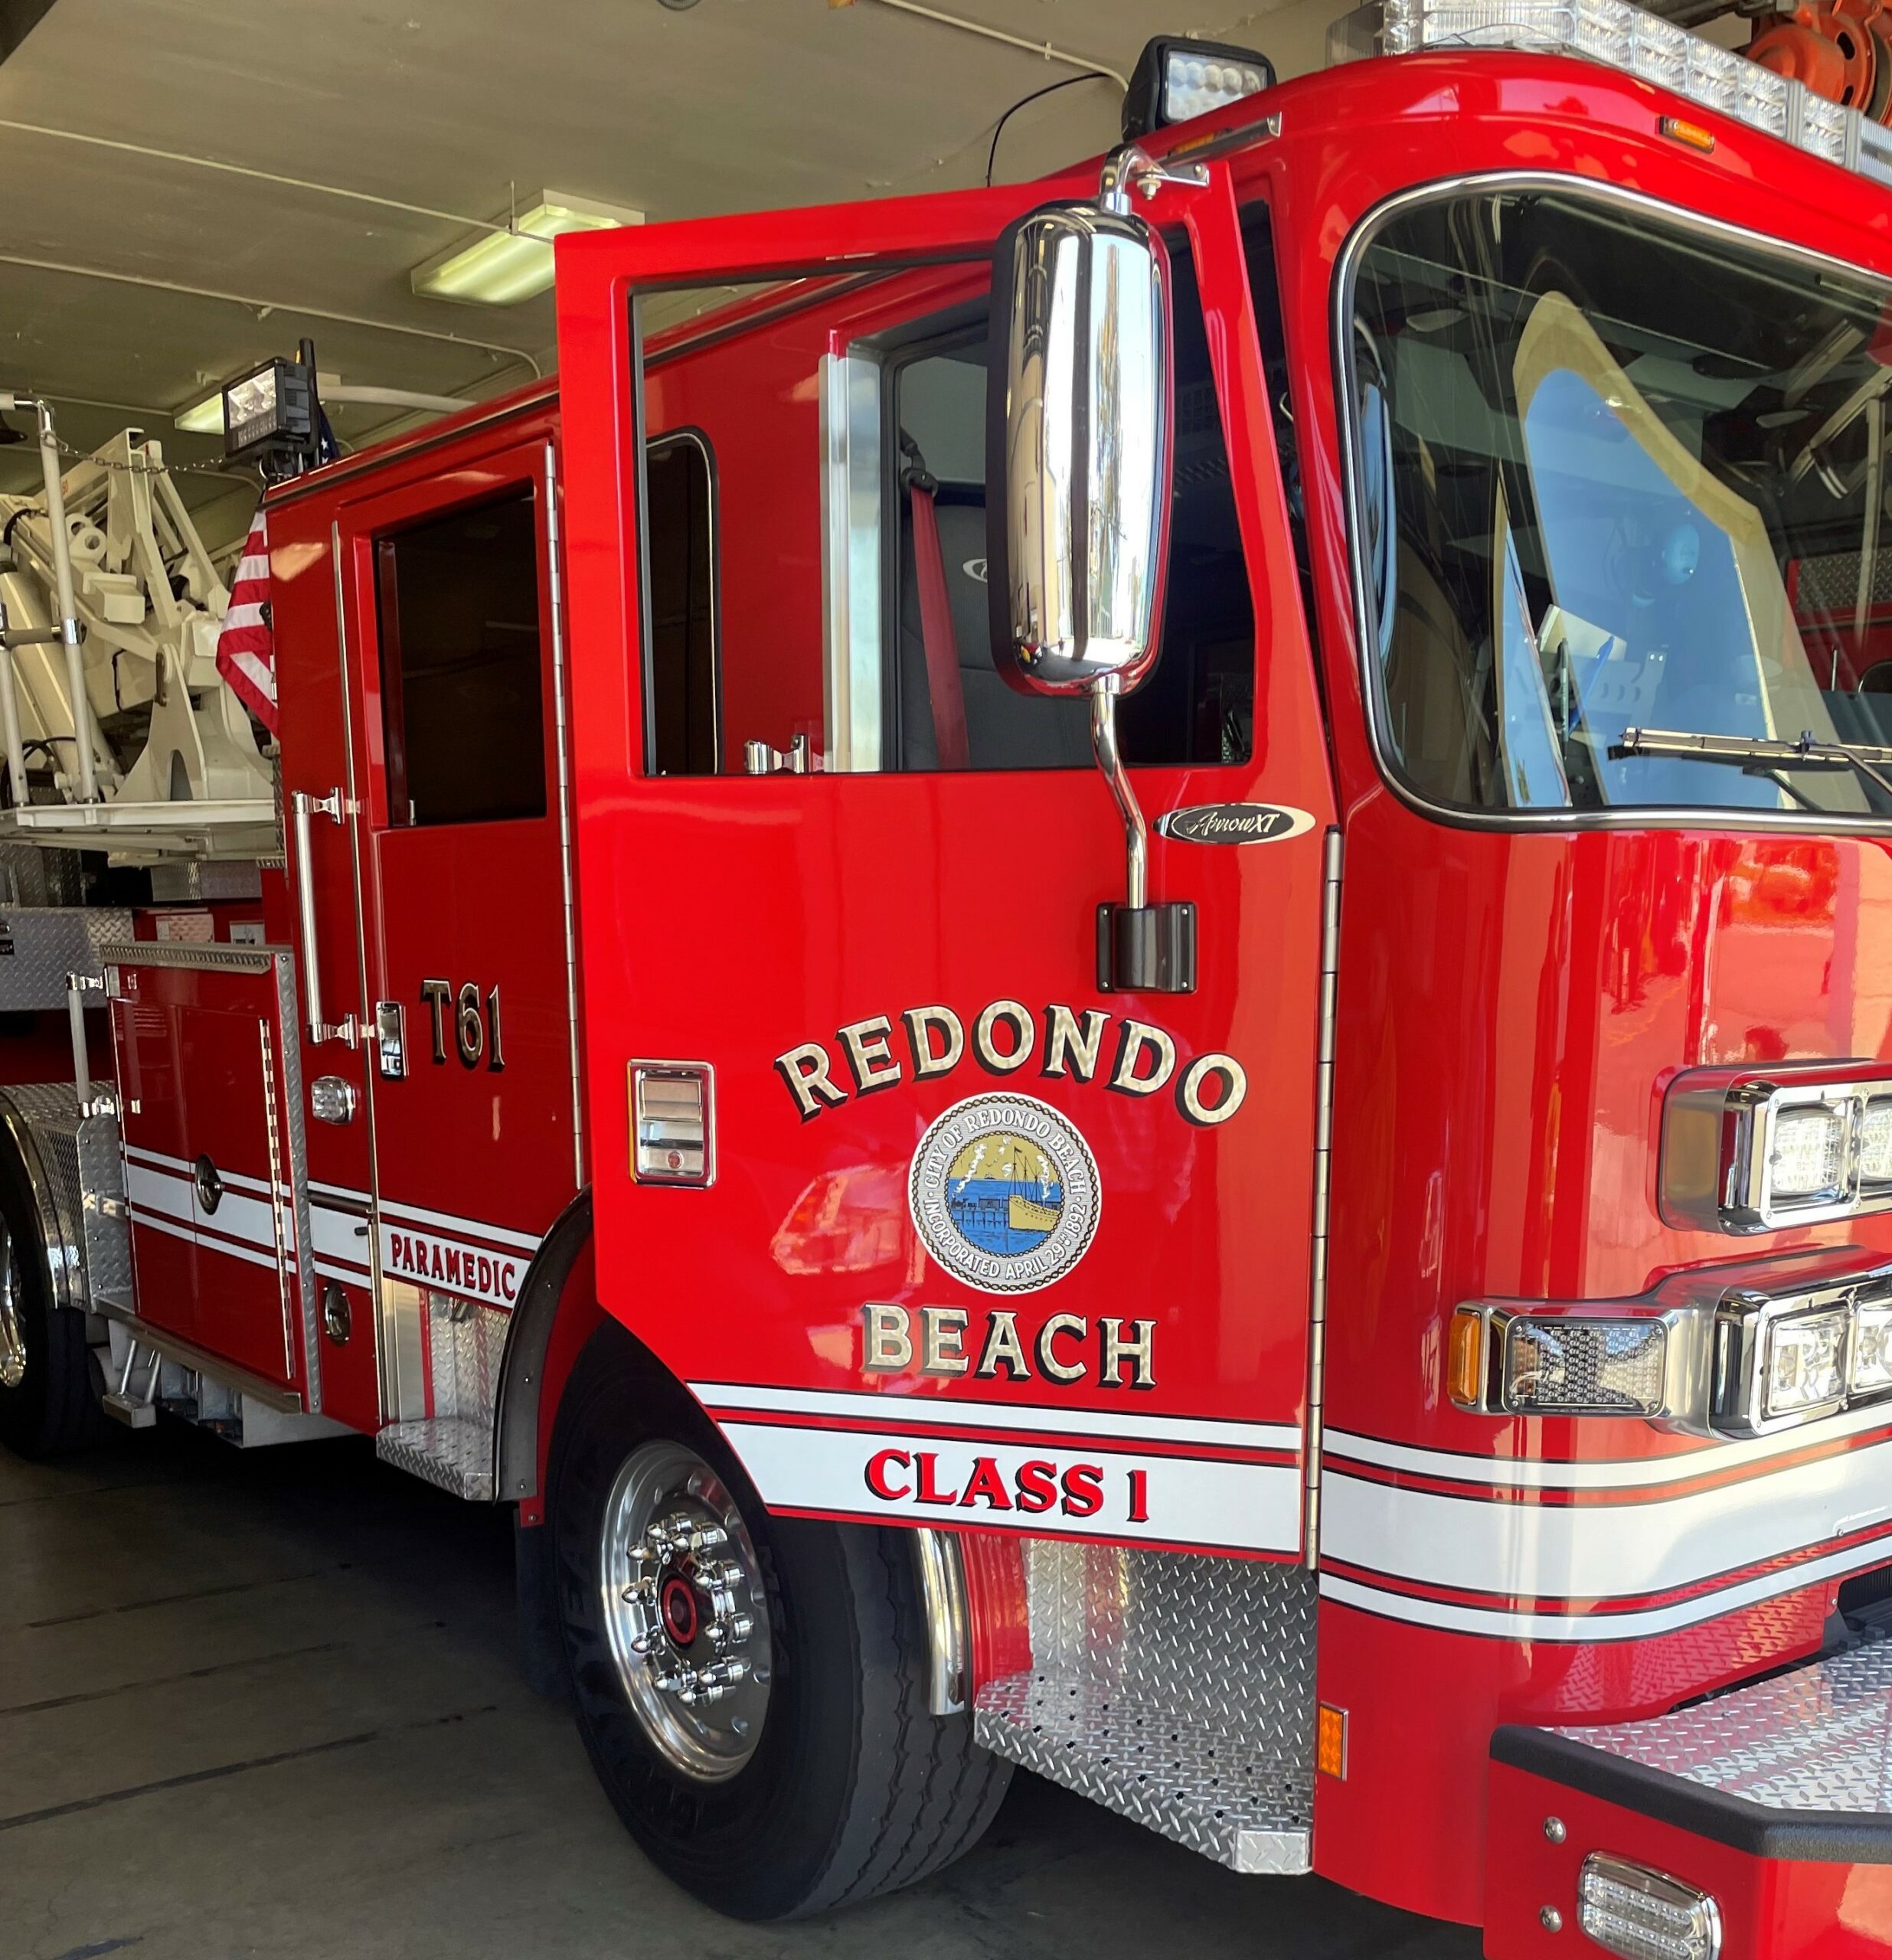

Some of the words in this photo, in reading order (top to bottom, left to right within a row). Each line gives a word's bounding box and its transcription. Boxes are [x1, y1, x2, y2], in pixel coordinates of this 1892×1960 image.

[420, 978, 506, 1073] T61
[774, 999, 1248, 1126] REDONDO
[924, 1145, 948, 1188] CITY
[942, 1124, 963, 1148] OF
[963, 1108, 1051, 1138] REDONDO
[1047, 1132, 1087, 1194] BEACH
[390, 1233, 516, 1301] PARAMEDIC
[923, 1198, 1000, 1278] INCORPORATED
[1005, 1256, 1049, 1279] APRIL
[862, 1302, 1157, 1390] BEACH
[864, 1449, 1104, 1517] CLASS
[1126, 1469, 1150, 1523] 1
